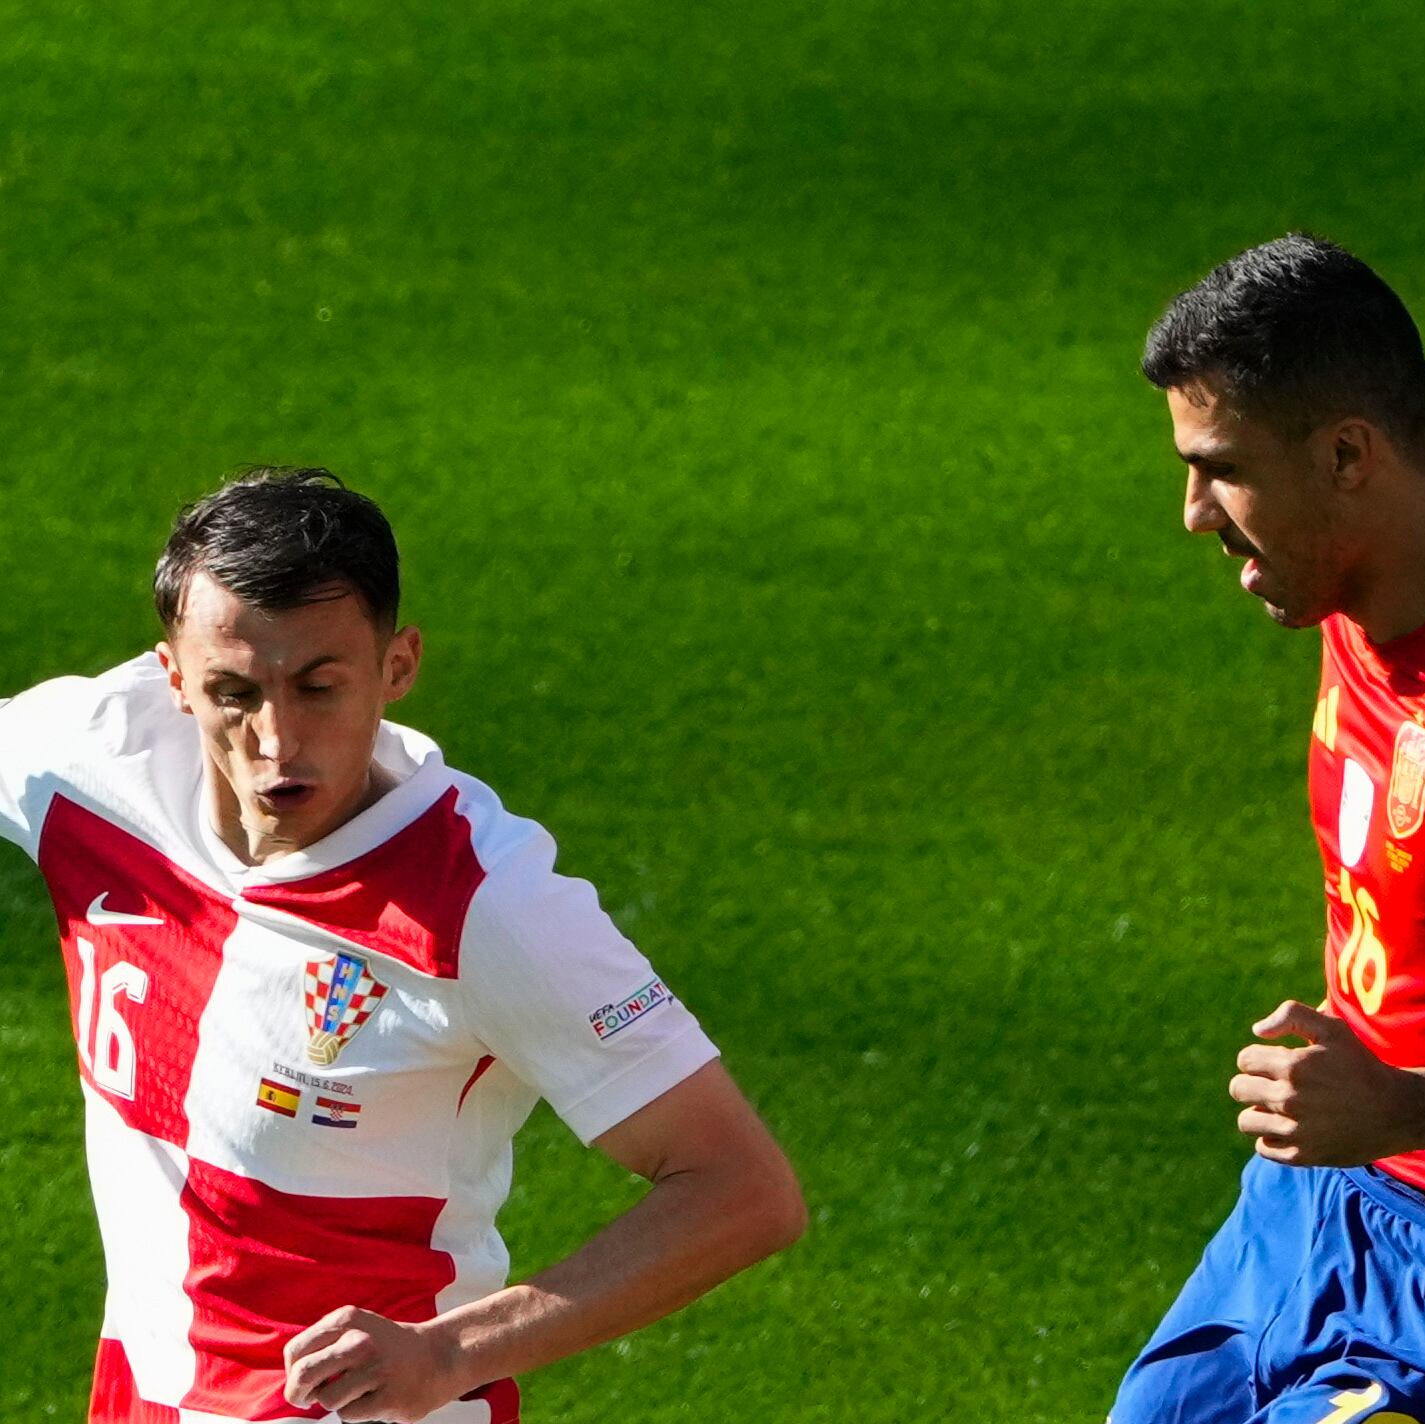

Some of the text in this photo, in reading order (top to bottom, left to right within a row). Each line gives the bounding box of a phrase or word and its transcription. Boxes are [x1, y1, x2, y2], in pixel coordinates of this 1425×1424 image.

[326, 962, 354, 1022] HNS
[1337, 866, 1388, 1016] 16
[77, 936, 149, 1102] 16
[589, 1003, 615, 1023] UEFA
